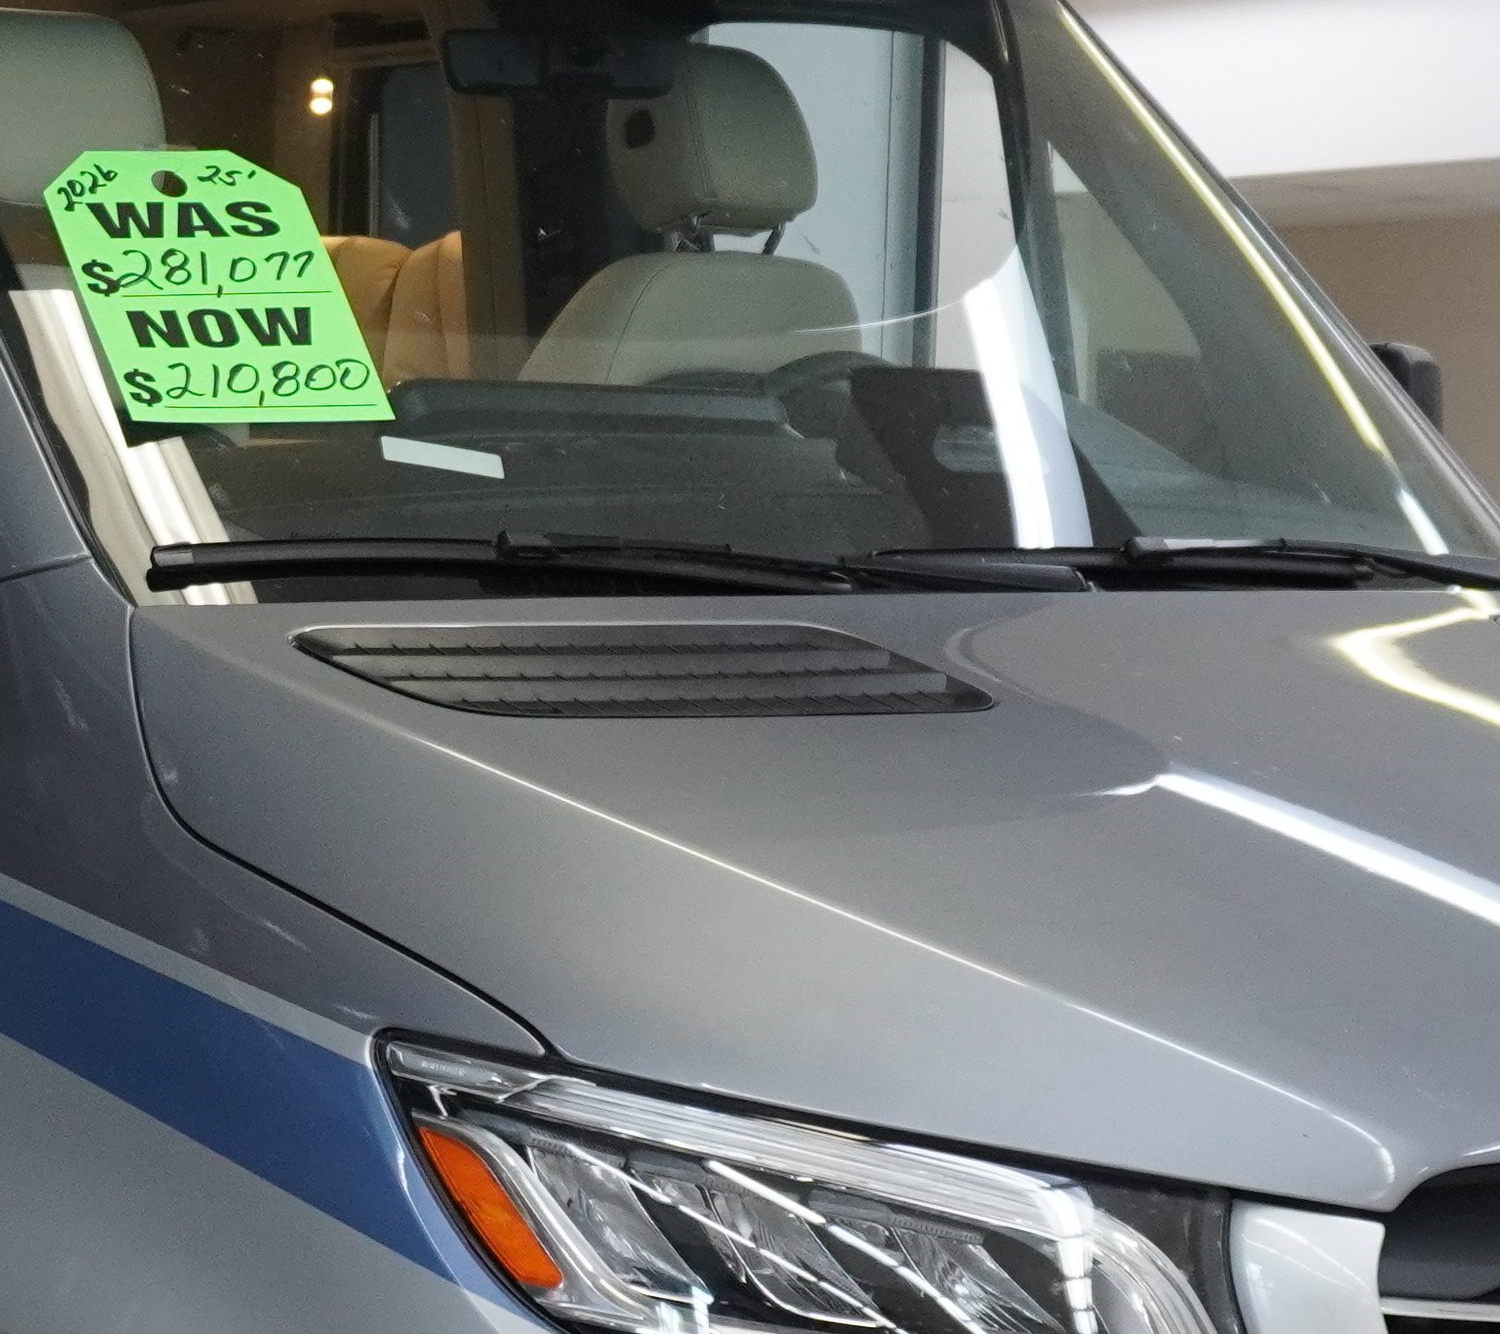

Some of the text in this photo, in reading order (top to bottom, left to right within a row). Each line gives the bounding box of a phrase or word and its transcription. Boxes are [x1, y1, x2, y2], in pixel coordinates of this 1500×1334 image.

[57, 163, 119, 212] 2026
[85, 200, 282, 239] WAS
[81, 247, 315, 298] $281,077
[125, 306, 313, 349] NOW
[123, 358, 371, 407] $210,800
